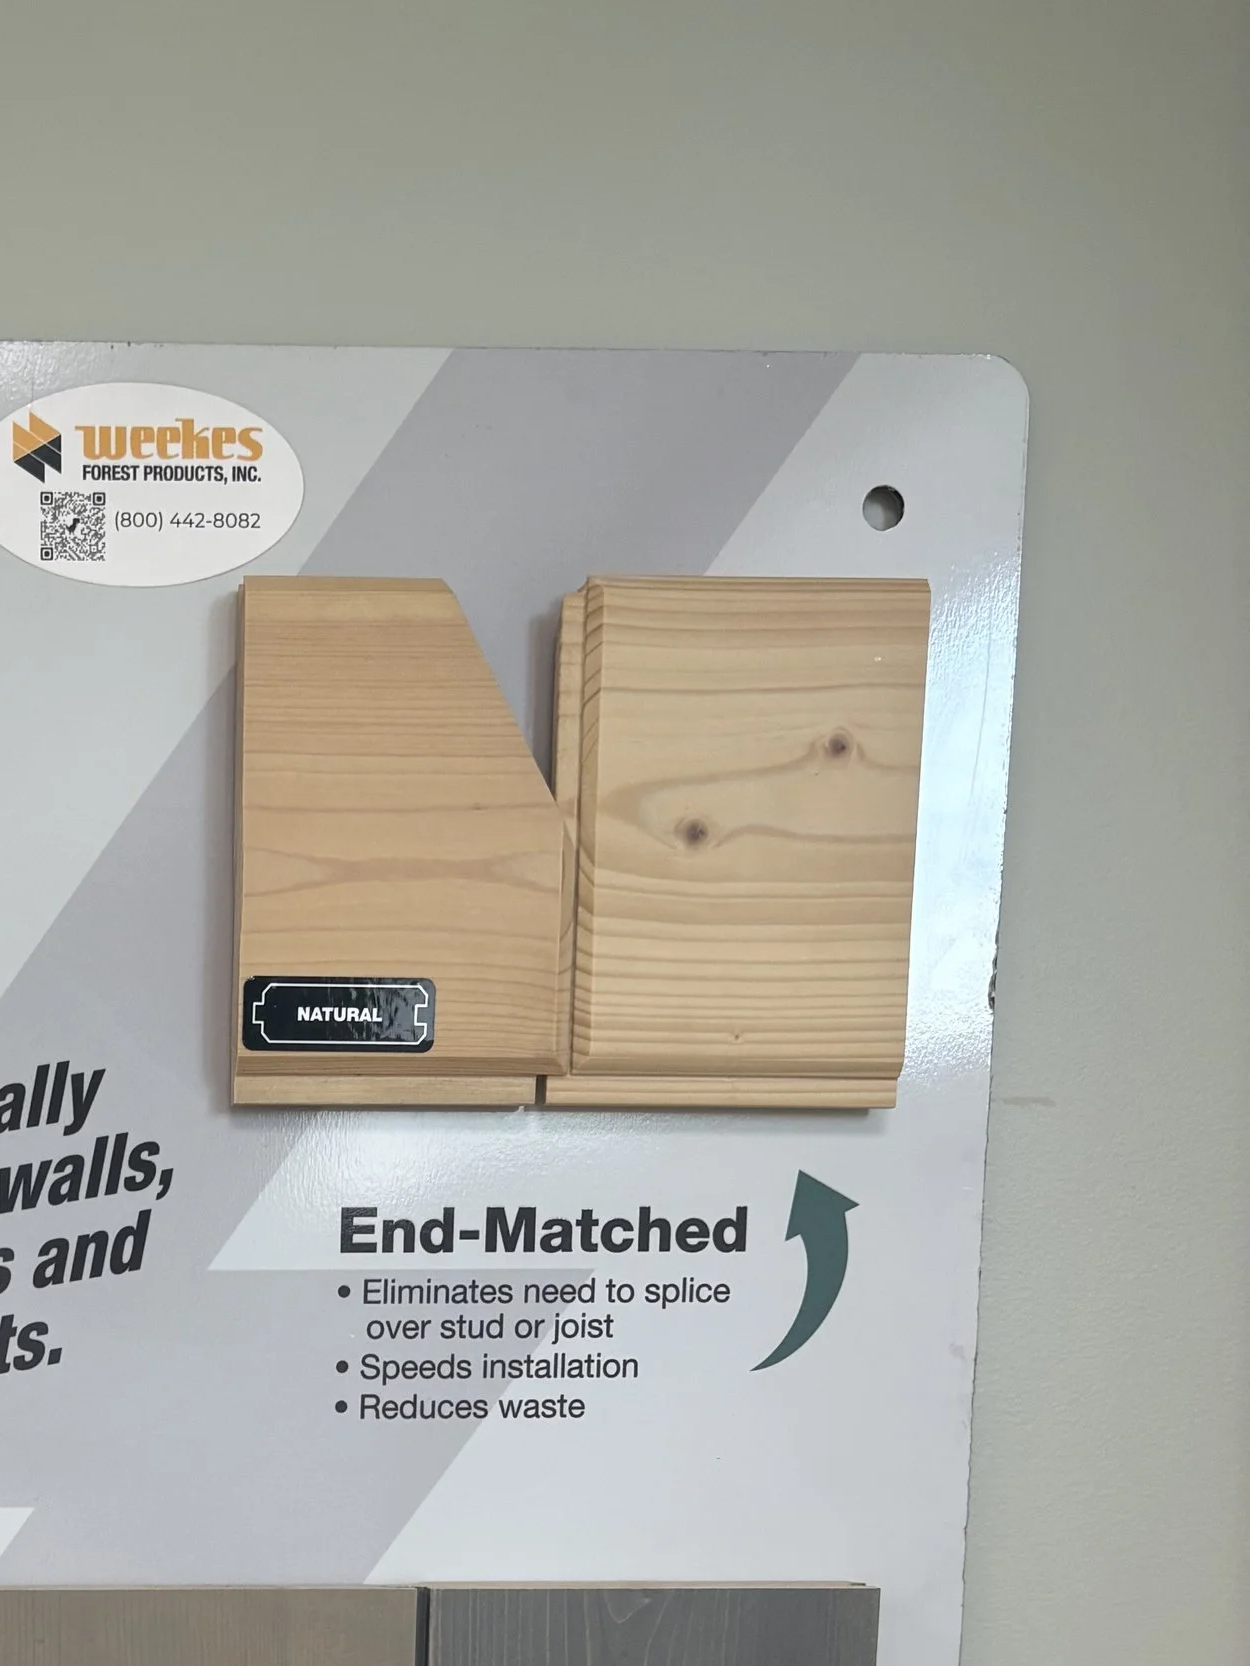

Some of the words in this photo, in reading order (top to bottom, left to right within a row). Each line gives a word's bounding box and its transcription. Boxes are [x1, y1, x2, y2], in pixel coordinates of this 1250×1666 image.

[75, 418, 263, 462] weekes
[83, 465, 140, 482] FOREST
[143, 465, 228, 484] PRODUCTS,
[231, 466, 262, 483] INC.
[114, 511, 164, 531] (800)
[170, 512, 261, 530] 442-8082
[297, 1006, 383, 1022] NATURAL
[340, 1205, 748, 1254] End-Matched
[32, 1209, 152, 1289] and
[362, 1278, 513, 1305] Eliminates
[524, 1278, 596, 1305] need
[606, 1282, 635, 1304] to
[644, 1277, 731, 1309] splice
[366, 1318, 431, 1340] over
[440, 1313, 505, 1340] stud
[514, 1318, 545, 1340] or
[552, 1313, 614, 1345] joist
[359, 1353, 472, 1386] Speeds
[482, 1353, 639, 1380] installation
[359, 1394, 489, 1420] Reduces
[499, 1398, 586, 1419] waste
